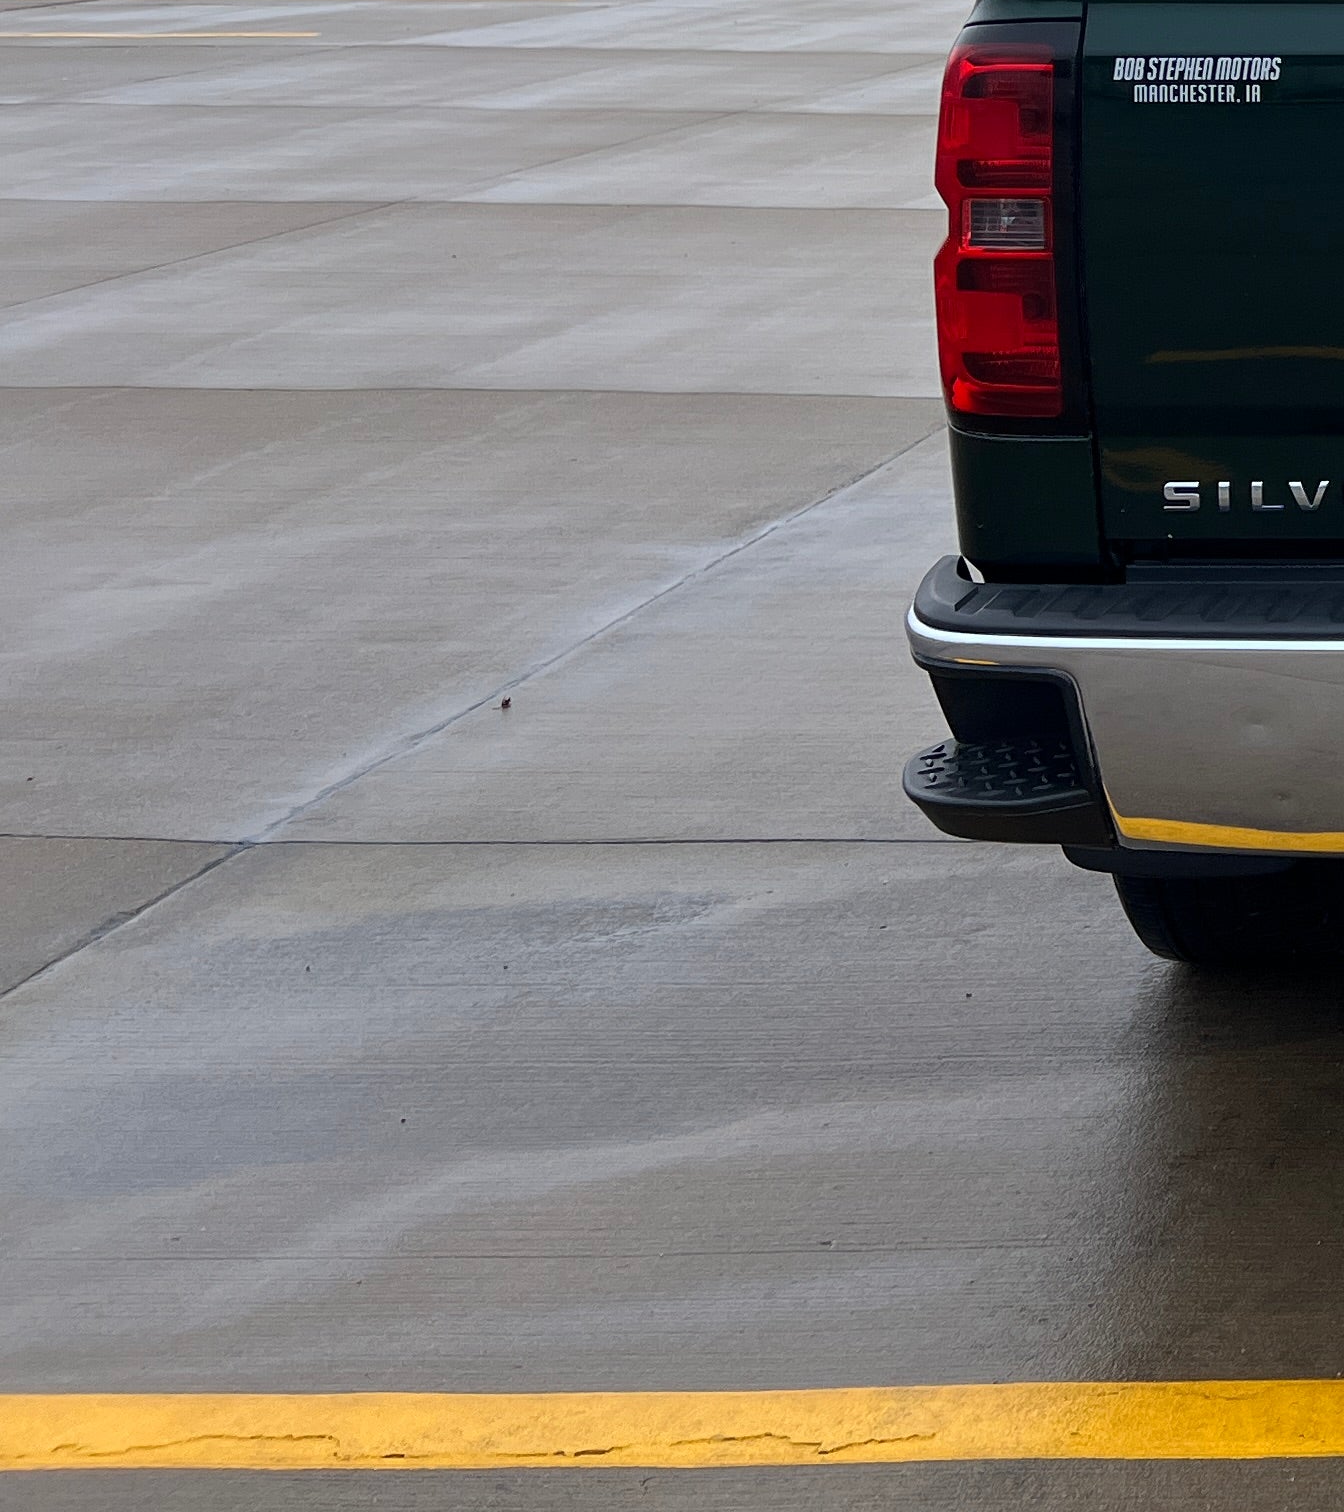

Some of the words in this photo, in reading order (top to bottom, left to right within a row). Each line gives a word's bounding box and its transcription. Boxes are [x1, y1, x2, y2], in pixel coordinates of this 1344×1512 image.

[1113, 57, 1146, 81] BOB
[1147, 57, 1214, 81] STEPHEN
[1215, 57, 1282, 81] MOTORS
[1246, 84, 1261, 103] IA
